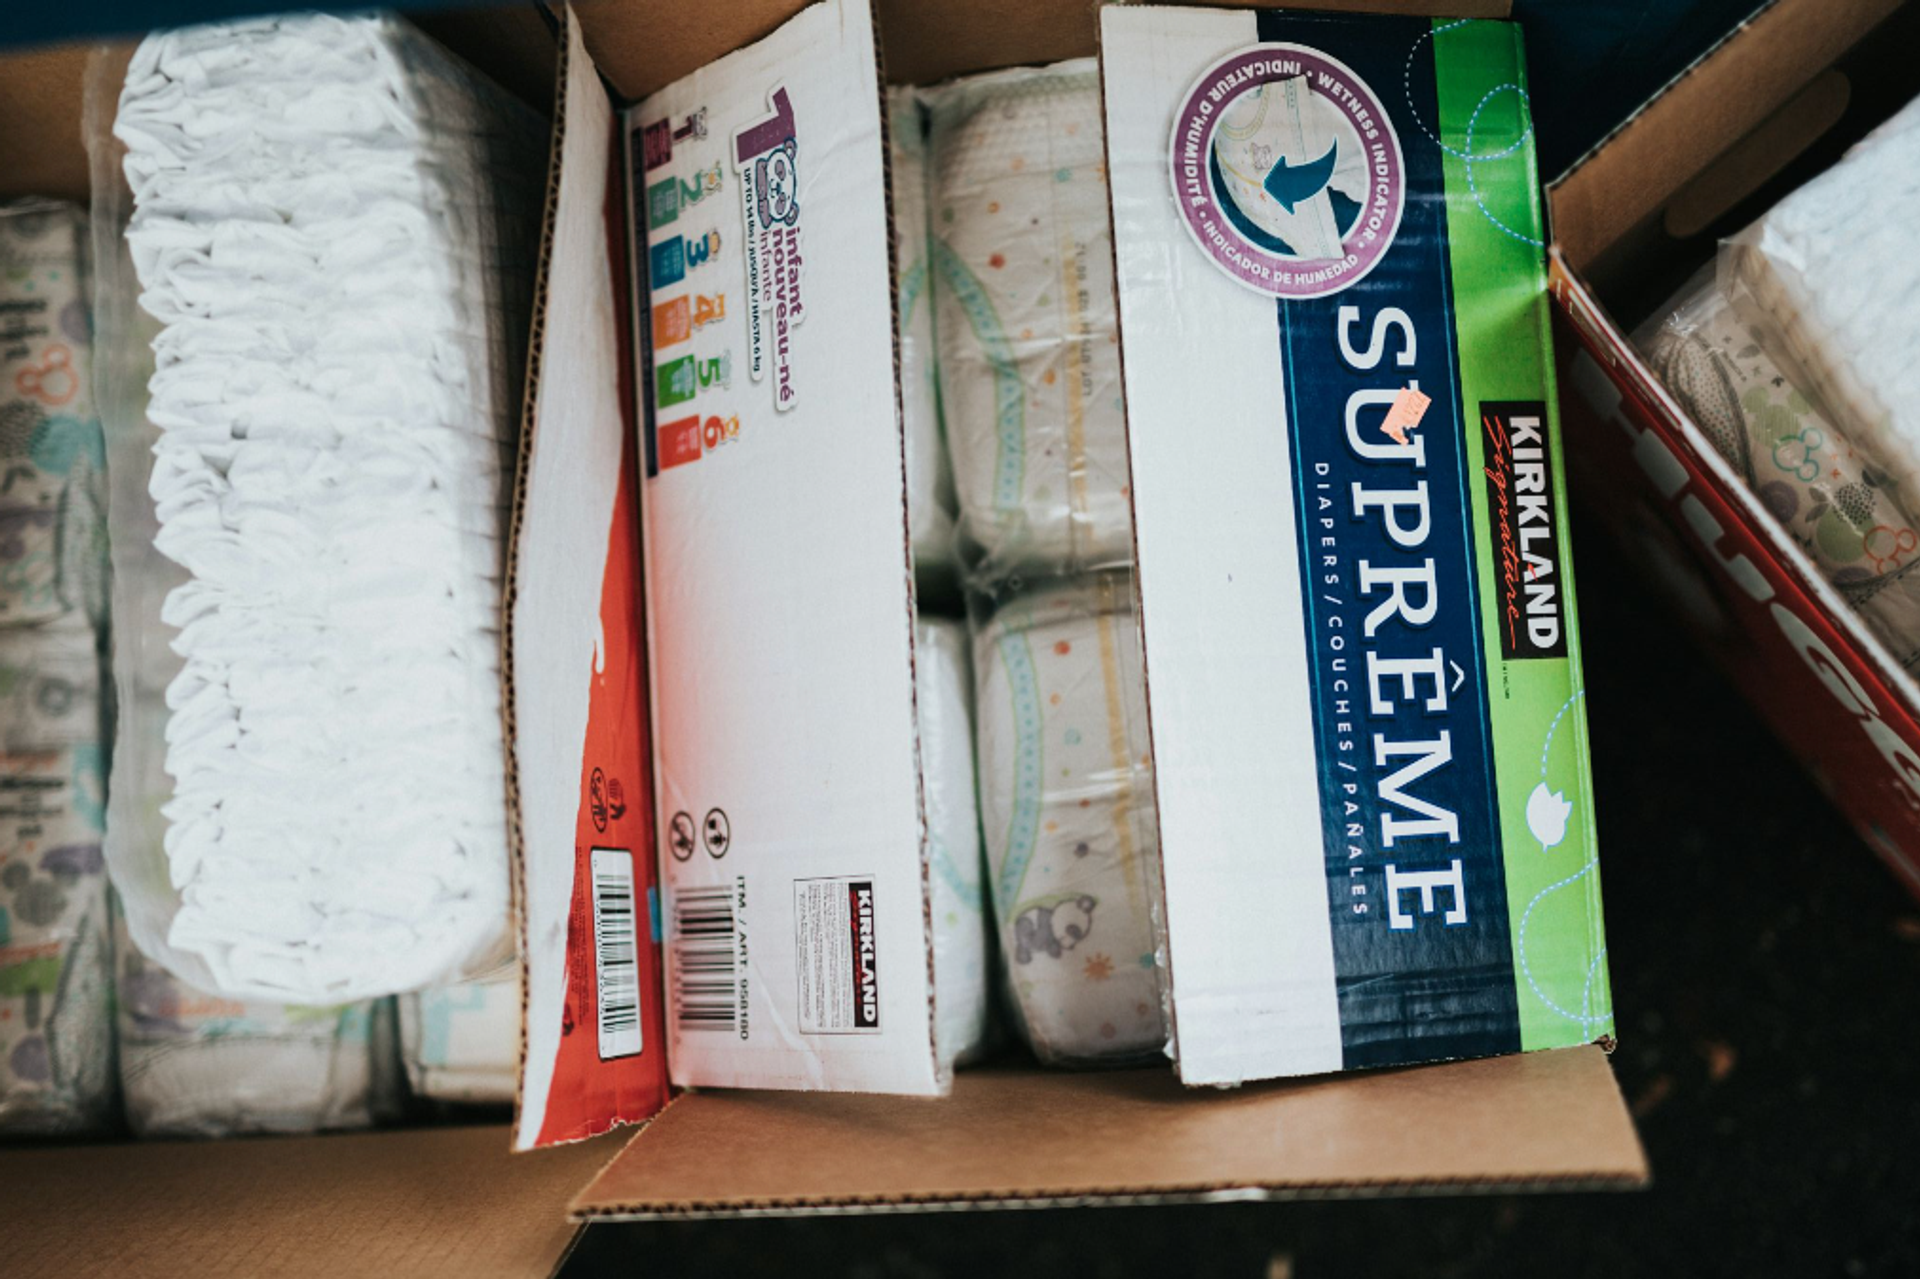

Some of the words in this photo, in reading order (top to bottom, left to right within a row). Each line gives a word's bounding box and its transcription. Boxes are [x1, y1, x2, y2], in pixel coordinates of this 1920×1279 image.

[1208, 60, 1302, 102] INDICATEUR
[680, 171, 703, 208] 2
[1184, 103, 1214, 208] D'HUMIDITÉ
[1318, 71, 1379, 140] WETNESS
[1362, 143, 1390, 241] INDICATOR
[686, 232, 709, 267] 3
[760, 230, 773, 303] infante
[786, 226, 804, 318] infant
[1203, 220, 1270, 280] INDICADOR
[1274, 268, 1292, 284] DE
[1295, 253, 1359, 285] HUMEDAD
[693, 294, 715, 327] 4
[773, 228, 795, 402] nouveau-né
[698, 358, 720, 387] 5
[704, 416, 725, 449] 6
[1483, 414, 1521, 650] Signature
[1509, 415, 1560, 649] KIRKLAND
[1338, 306, 1467, 930] SUPRÊME
[736, 875, 747, 913] ITM.
[738, 932, 748, 973] ART.
[857, 889, 876, 1022] KIRKLAND
